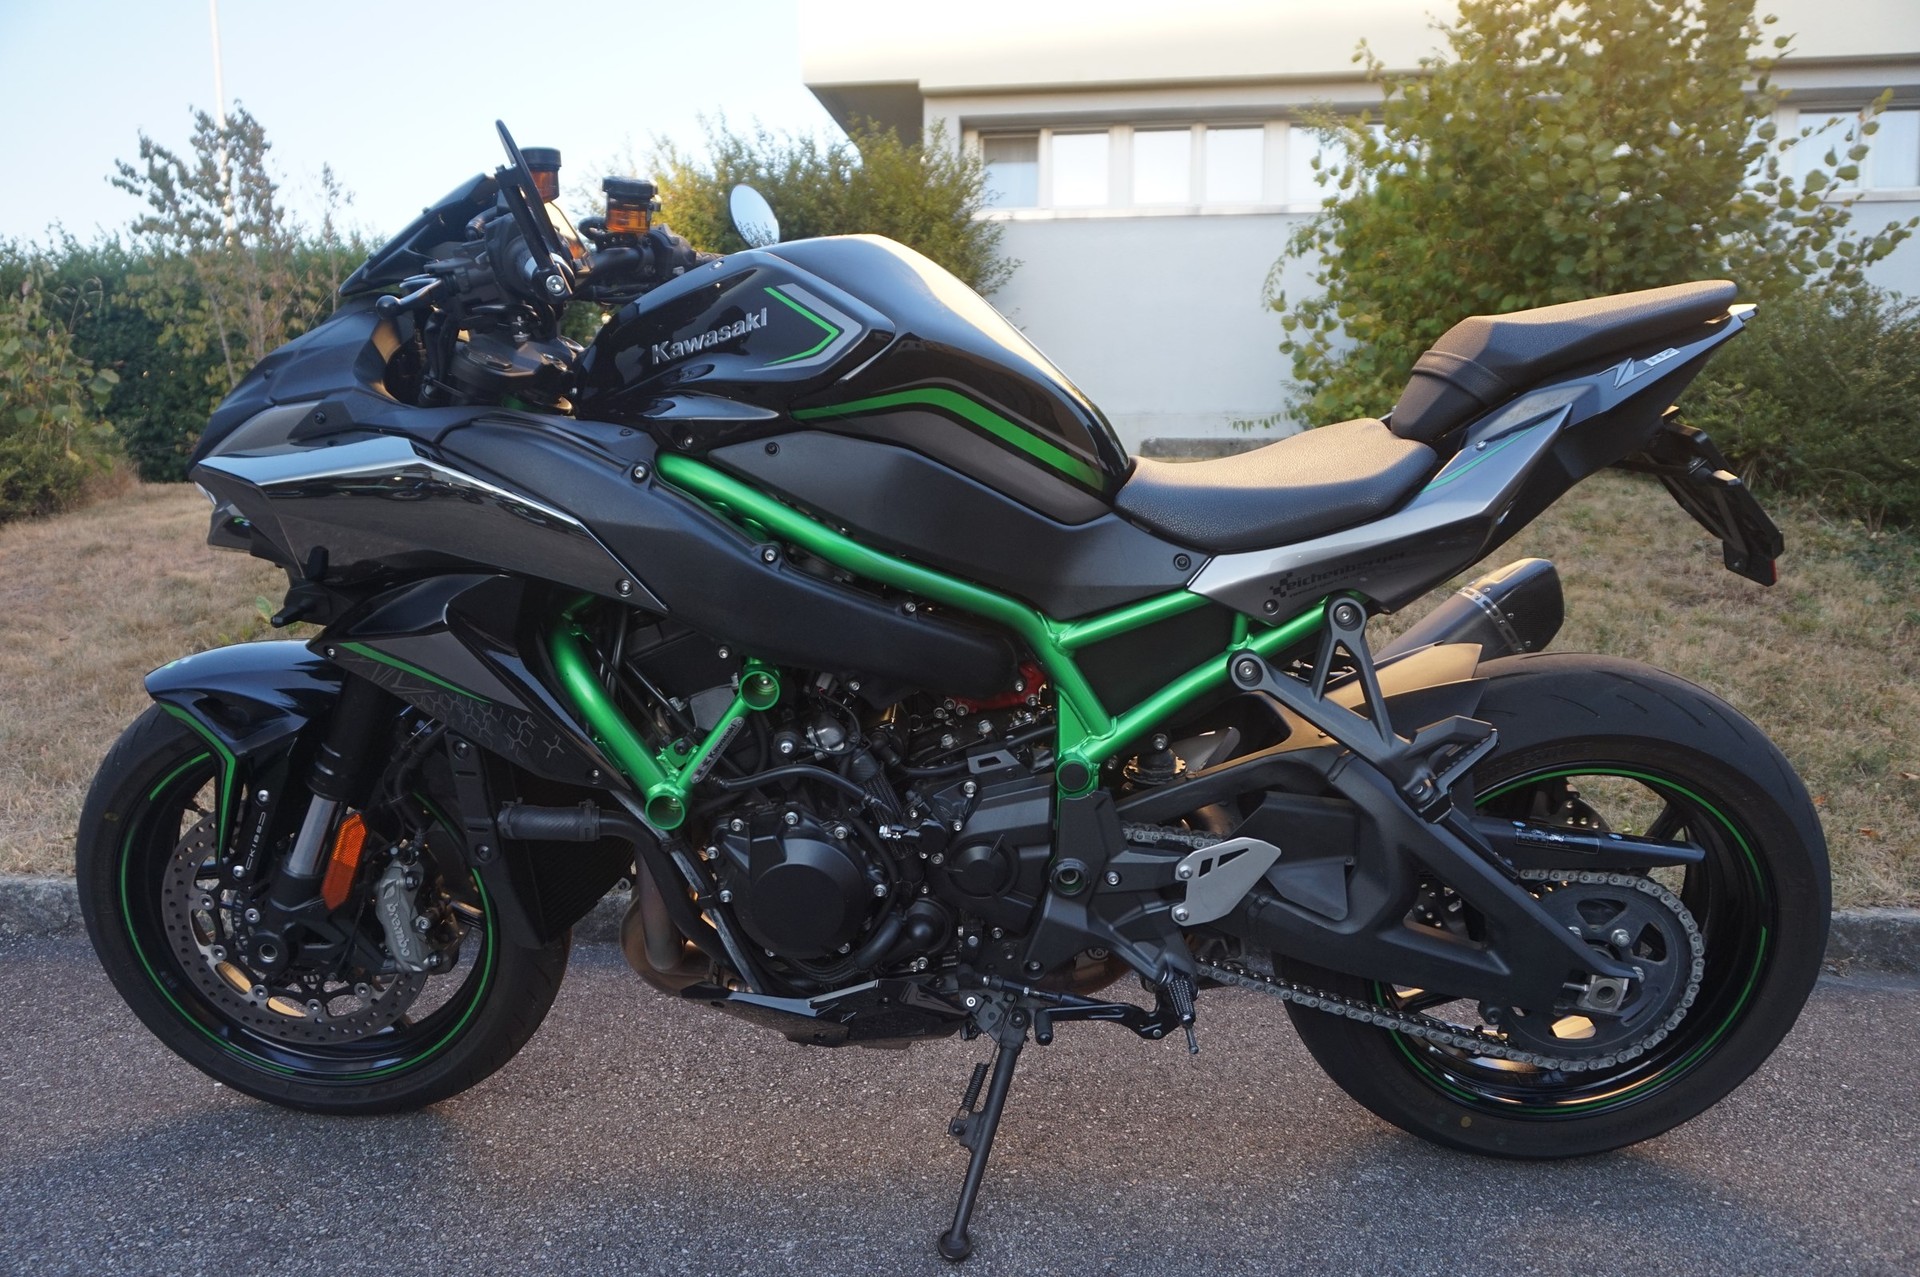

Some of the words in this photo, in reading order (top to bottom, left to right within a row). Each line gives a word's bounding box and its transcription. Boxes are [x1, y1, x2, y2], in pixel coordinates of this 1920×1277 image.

[651, 307, 768, 365] Kawasaki
[707, 724, 737, 759] Kawasaki
[386, 902, 410, 957] brembo
